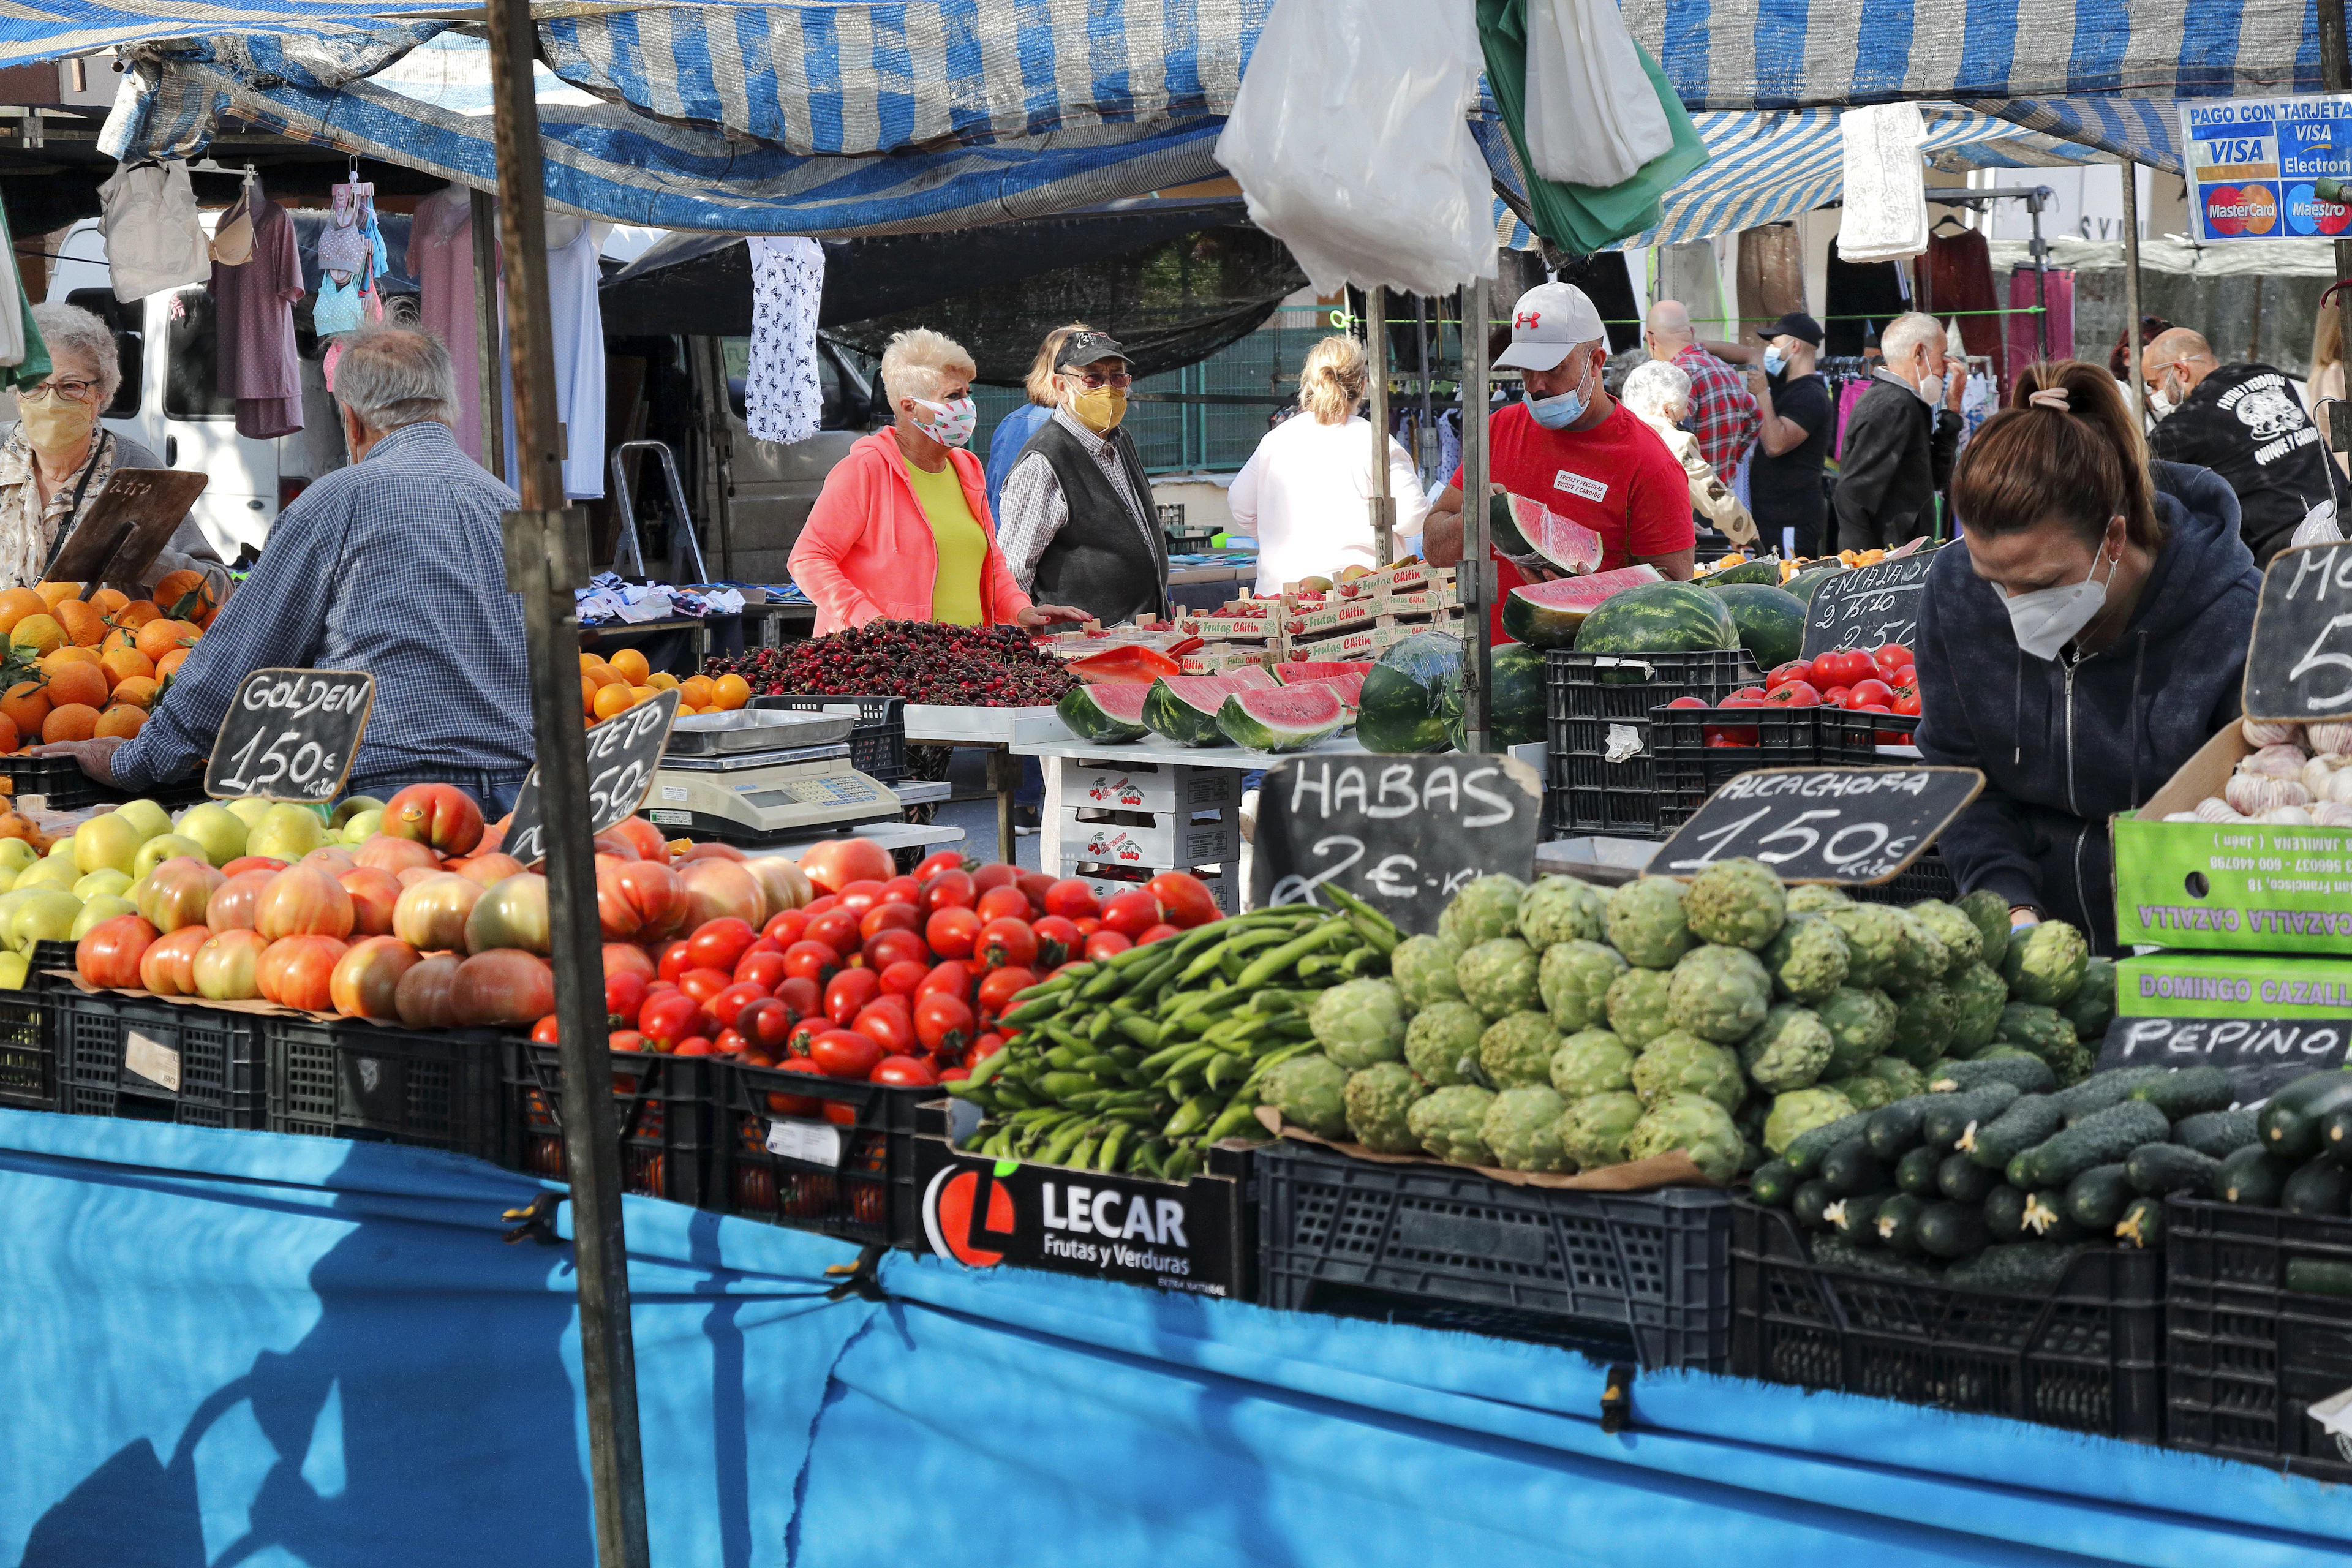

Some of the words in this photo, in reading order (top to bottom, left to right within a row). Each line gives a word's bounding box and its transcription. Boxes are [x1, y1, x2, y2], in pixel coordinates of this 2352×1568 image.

[2190, 107, 2235, 124] PAGO
[2240, 104, 2276, 121] CON
[2280, 101, 2352, 119] TARJETA
[2294, 124, 2331, 141] VISA
[2207, 140, 2264, 164] VISA
[2284, 156, 2350, 173] Electron
[2209, 202, 2275, 219] MasterCard
[2292, 202, 2345, 217] Maestro
[2243, 373, 2285, 391] VERDURAS
[2255, 437, 2290, 466] QUIQUE
[2286, 434, 2295, 450] Y
[1556, 481, 1575, 490] QUIQUE
[1579, 488, 1602, 499] CANDIDO
[1559, 474, 1577, 483] FRUTAS
[1580, 480, 1604, 492] VERDURAS
[1363, 577, 1392, 591] Frutas
[1393, 569, 1420, 584] Chitin
[1309, 614, 1337, 628] Frutas
[1338, 606, 1365, 620] Chitin
[1815, 604, 1836, 624] 2
[1204, 621, 1231, 634] Frutas
[1233, 622, 1259, 633] Chitin
[1394, 627, 1411, 635] Frutas
[1412, 627, 1427, 635] Chitin
[1313, 643, 1341, 657] Frutas
[1343, 635, 1371, 650] Chitin
[1178, 658, 1204, 671] Chitin
[1227, 657, 1244, 665] Frutas
[1245, 655, 1261, 664] Chitin
[243, 675, 371, 719] GOLDEN
[1290, 760, 1515, 828] HABAS
[1718, 772, 1930, 799] ALCACHOFA
[2273, 835, 2341, 851] JAMILENA
[2209, 856, 2255, 870] 440798
[2258, 858, 2282, 872] 600
[2295, 858, 2342, 873] 566037
[2248, 878, 2263, 892] 18
[2266, 876, 2331, 895] Francisco,
[2137, 905, 2241, 932] CAZALLA
[2247, 909, 2352, 936] CAZALLA
[2140, 974, 2252, 1003] DOMINGO
[1042, 1182, 1189, 1248] LECAR
[1044, 1232, 1097, 1262] Frutas
[1099, 1245, 1112, 1268] y
[1112, 1243, 1190, 1276] Verduras
